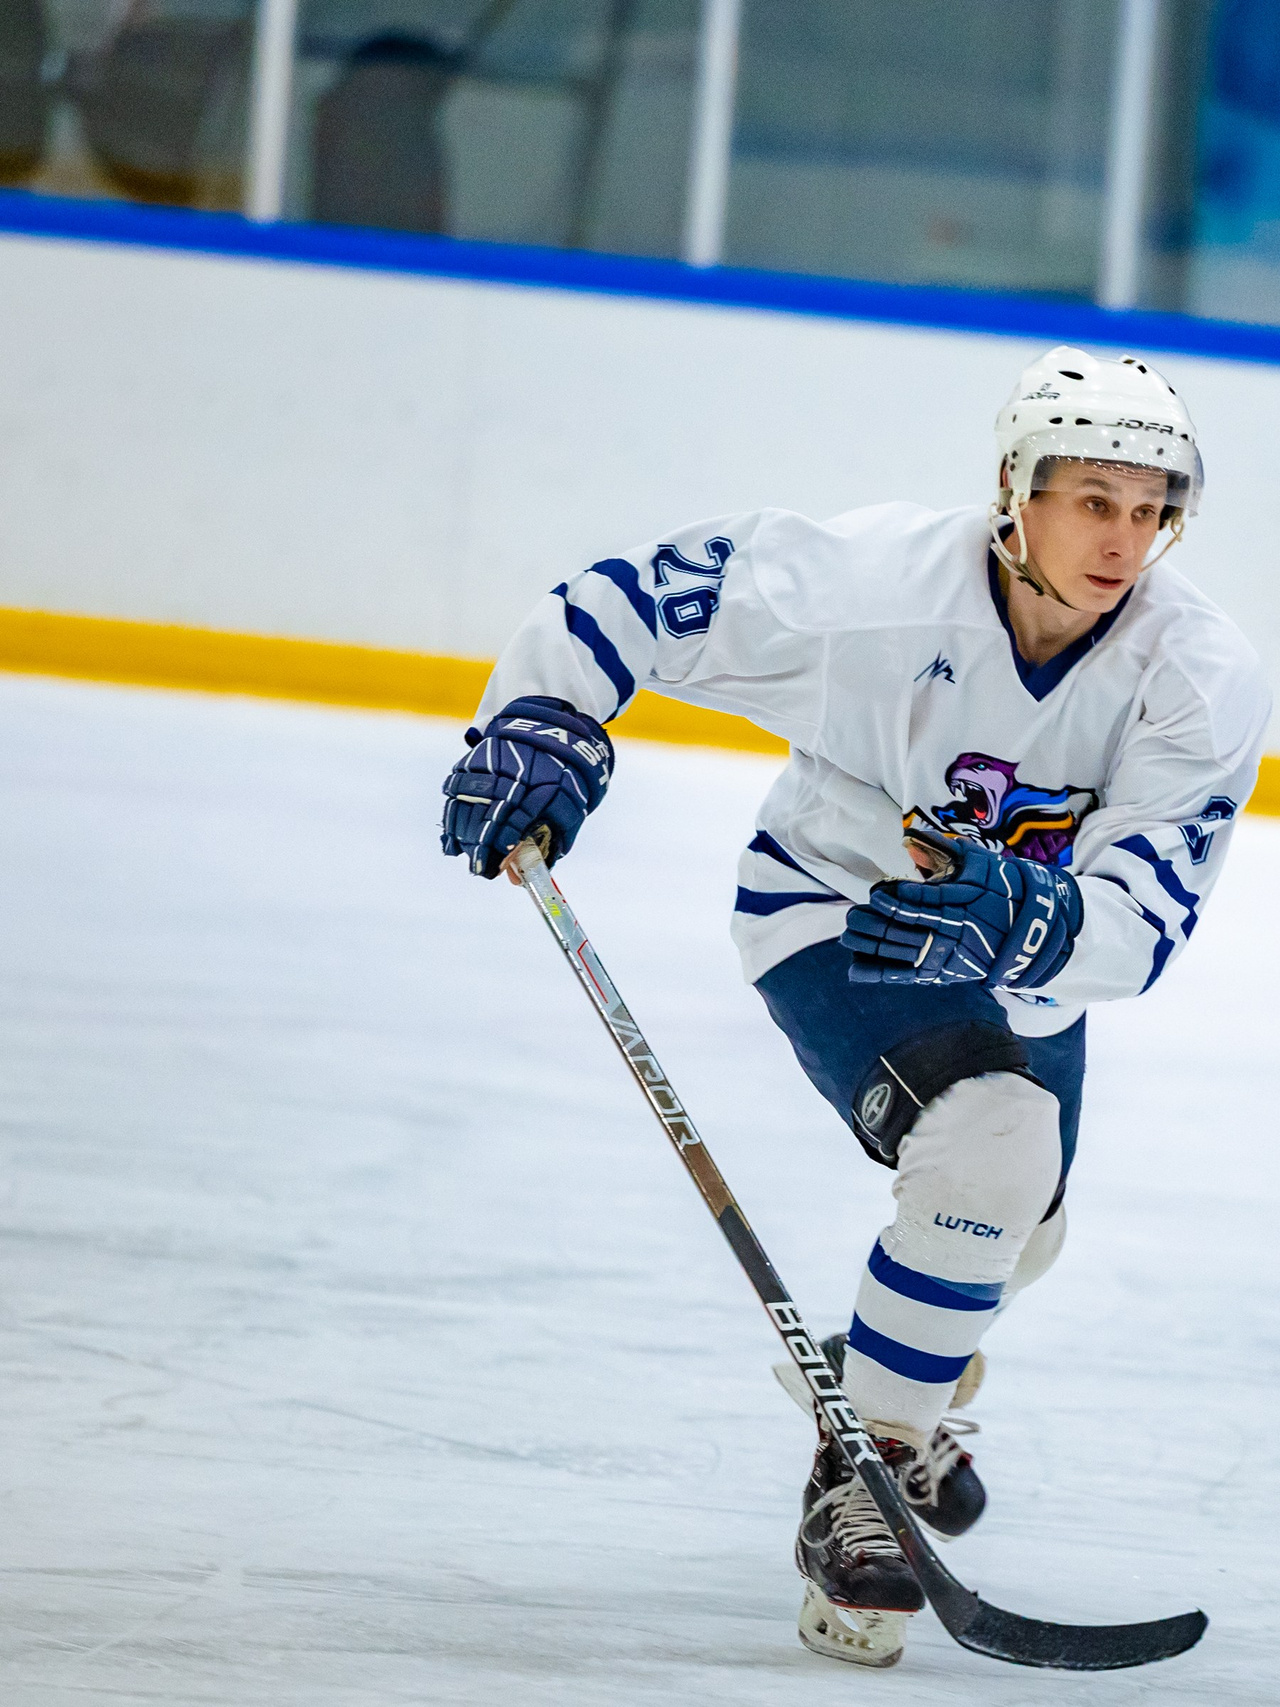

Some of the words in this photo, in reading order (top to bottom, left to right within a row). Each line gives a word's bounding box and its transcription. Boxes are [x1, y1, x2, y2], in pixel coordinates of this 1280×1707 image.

[1107, 417, 1174, 436] JOFA
[609, 1010, 702, 1150] VAPOR
[933, 1212, 1004, 1240] LUTCH
[765, 1301, 885, 1466] BAUER
